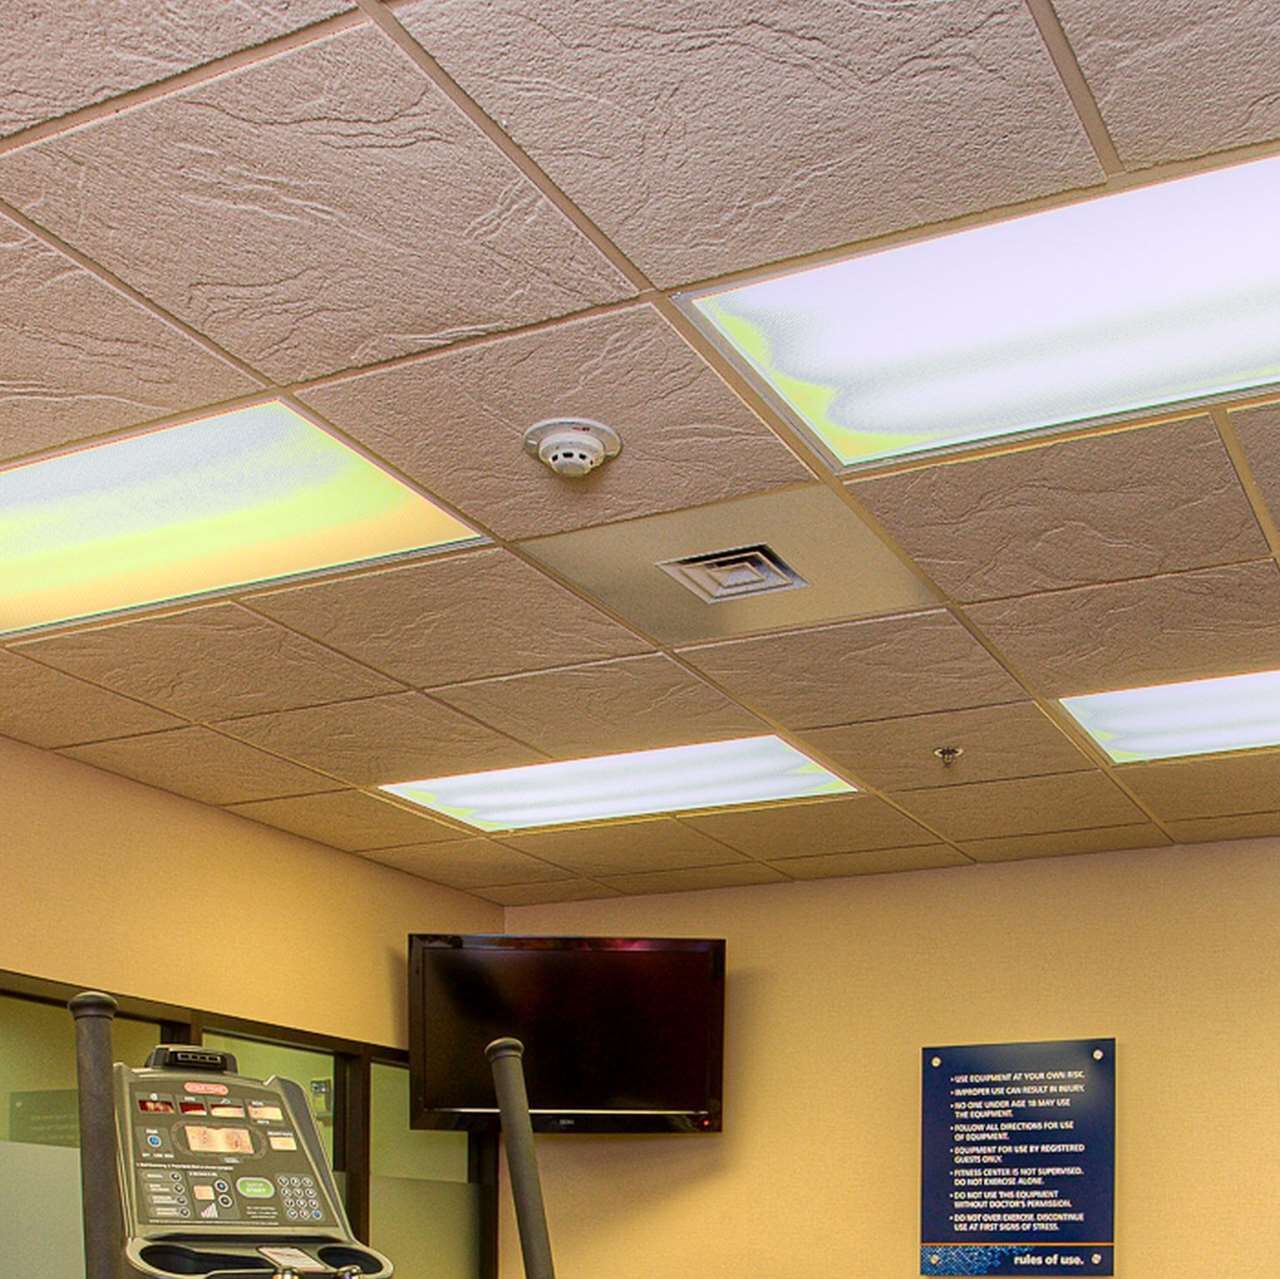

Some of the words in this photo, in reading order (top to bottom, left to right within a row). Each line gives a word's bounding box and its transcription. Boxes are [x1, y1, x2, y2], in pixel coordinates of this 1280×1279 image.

[1014, 1254, 1043, 1265] rules
[1045, 1253, 1058, 1265] of
[1060, 1256, 1084, 1265] use.
